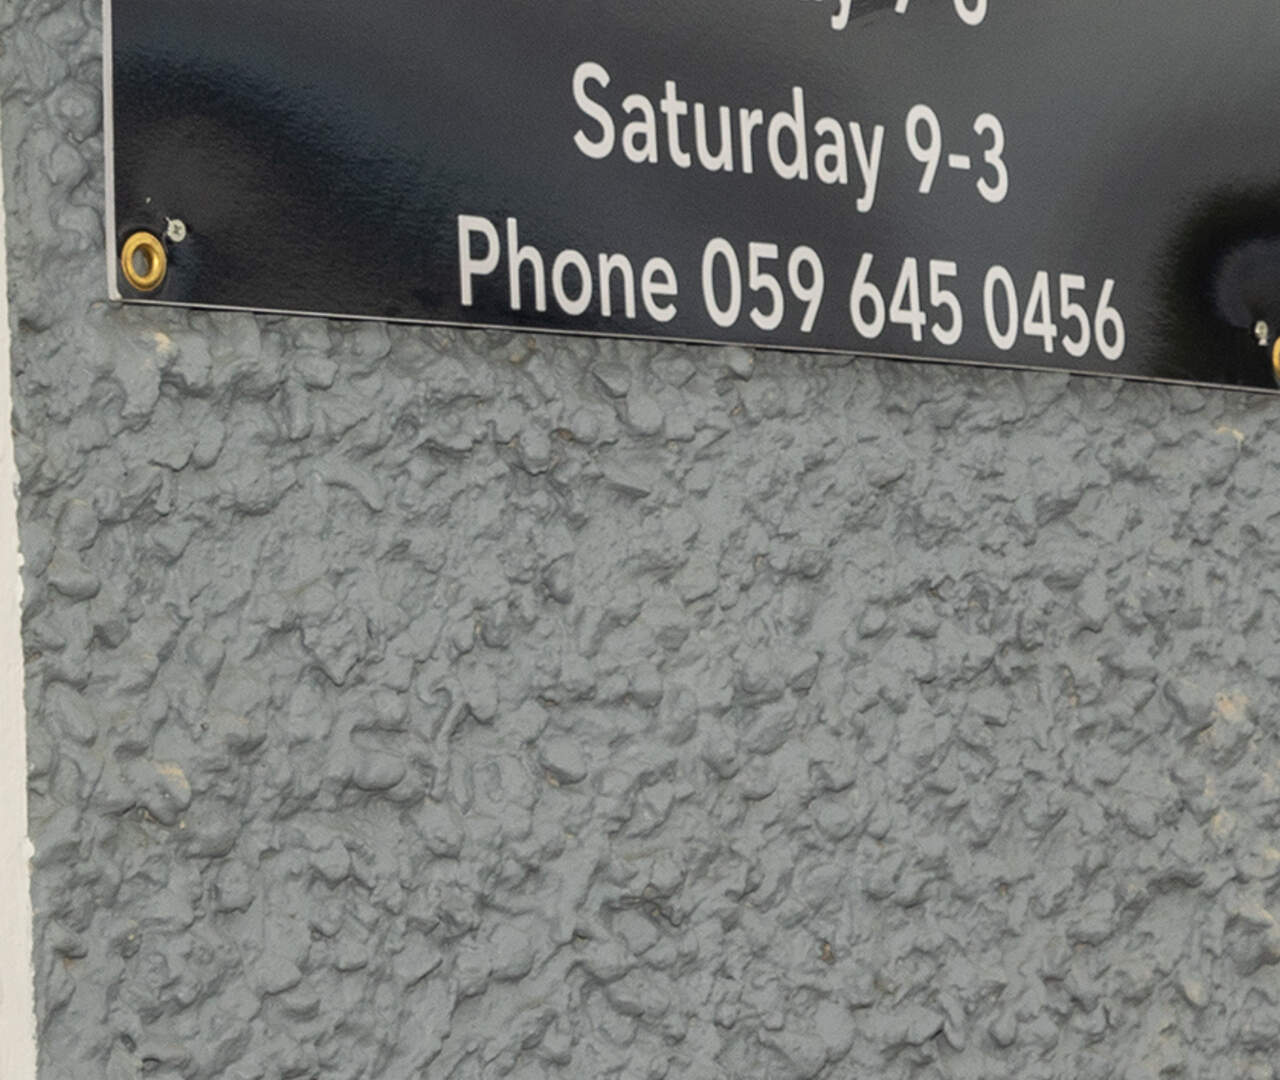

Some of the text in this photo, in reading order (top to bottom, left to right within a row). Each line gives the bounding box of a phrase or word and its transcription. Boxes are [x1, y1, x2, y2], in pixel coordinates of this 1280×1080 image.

[572, 61, 1010, 214] Saturday 9-3
[457, 214, 1125, 361] Phone 059 645 0456
